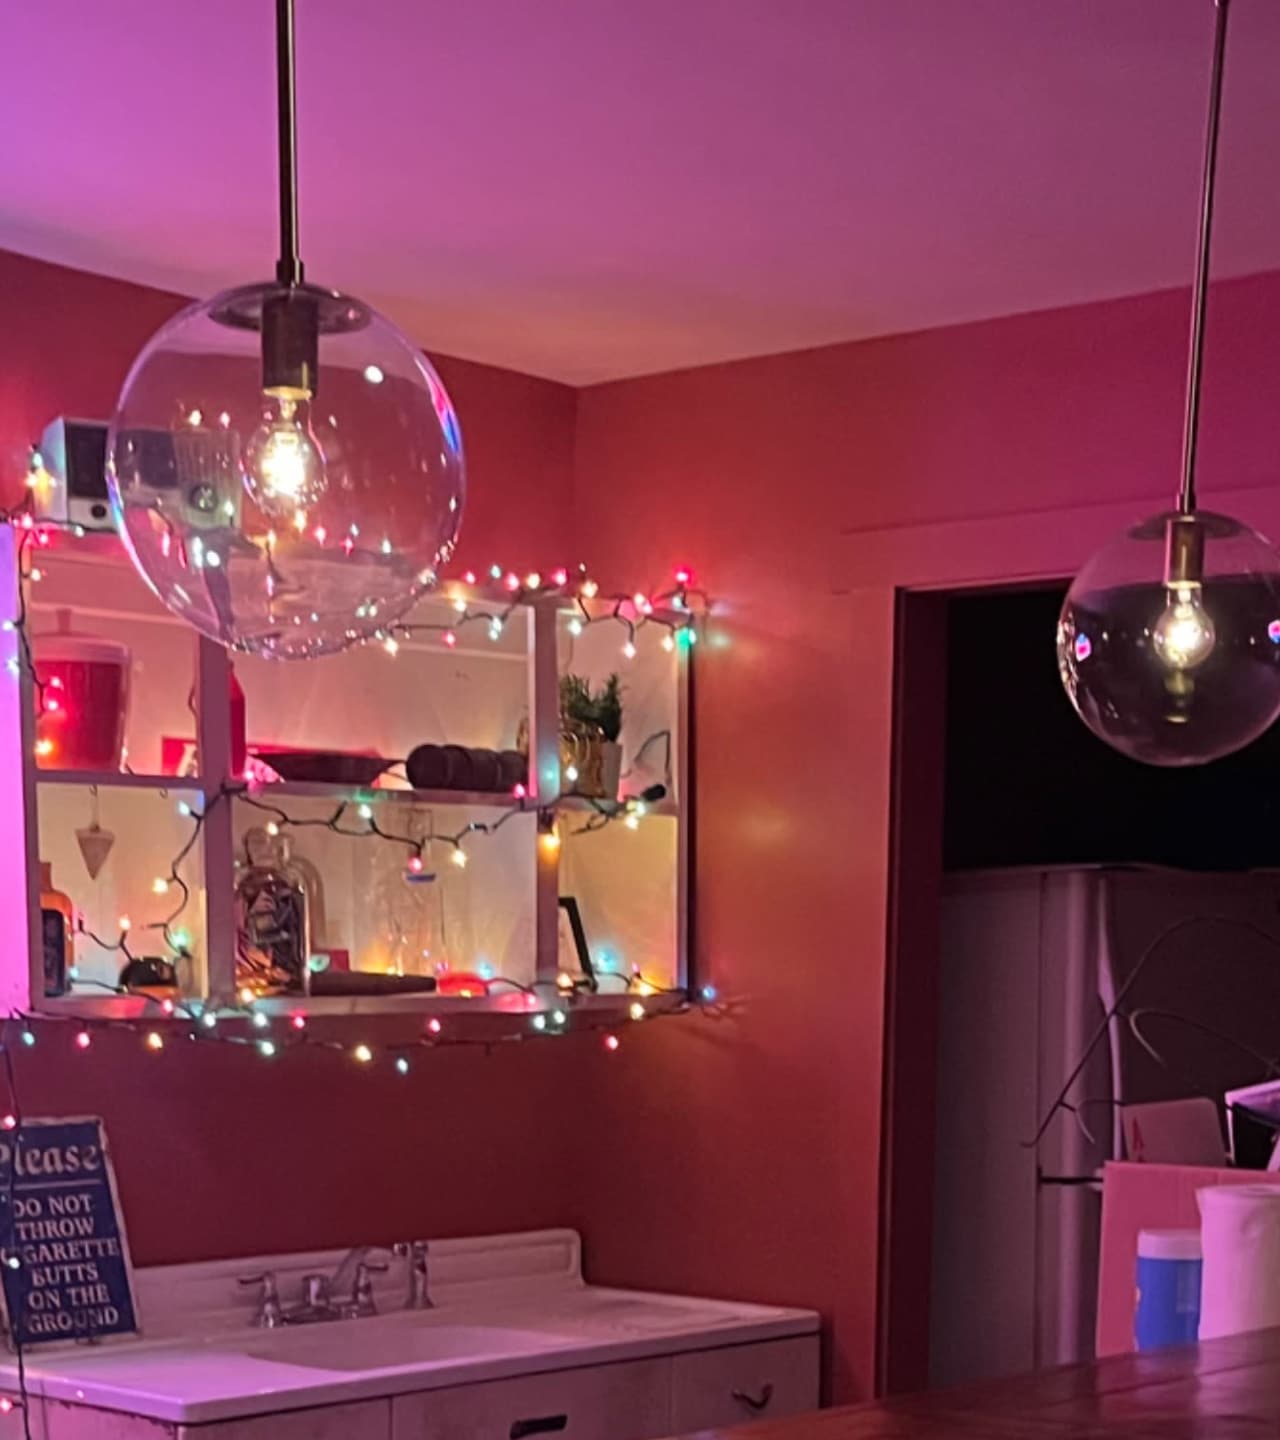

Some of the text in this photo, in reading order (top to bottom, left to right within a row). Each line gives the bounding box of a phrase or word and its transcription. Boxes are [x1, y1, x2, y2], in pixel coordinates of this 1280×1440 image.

[13, 1193, 92, 1218] DO NOT
[14, 1216, 95, 1241] THROW
[31, 1262, 99, 1288] BUTTS
[27, 1283, 111, 1310] ON THE
[27, 1306, 120, 1334] GROUND
